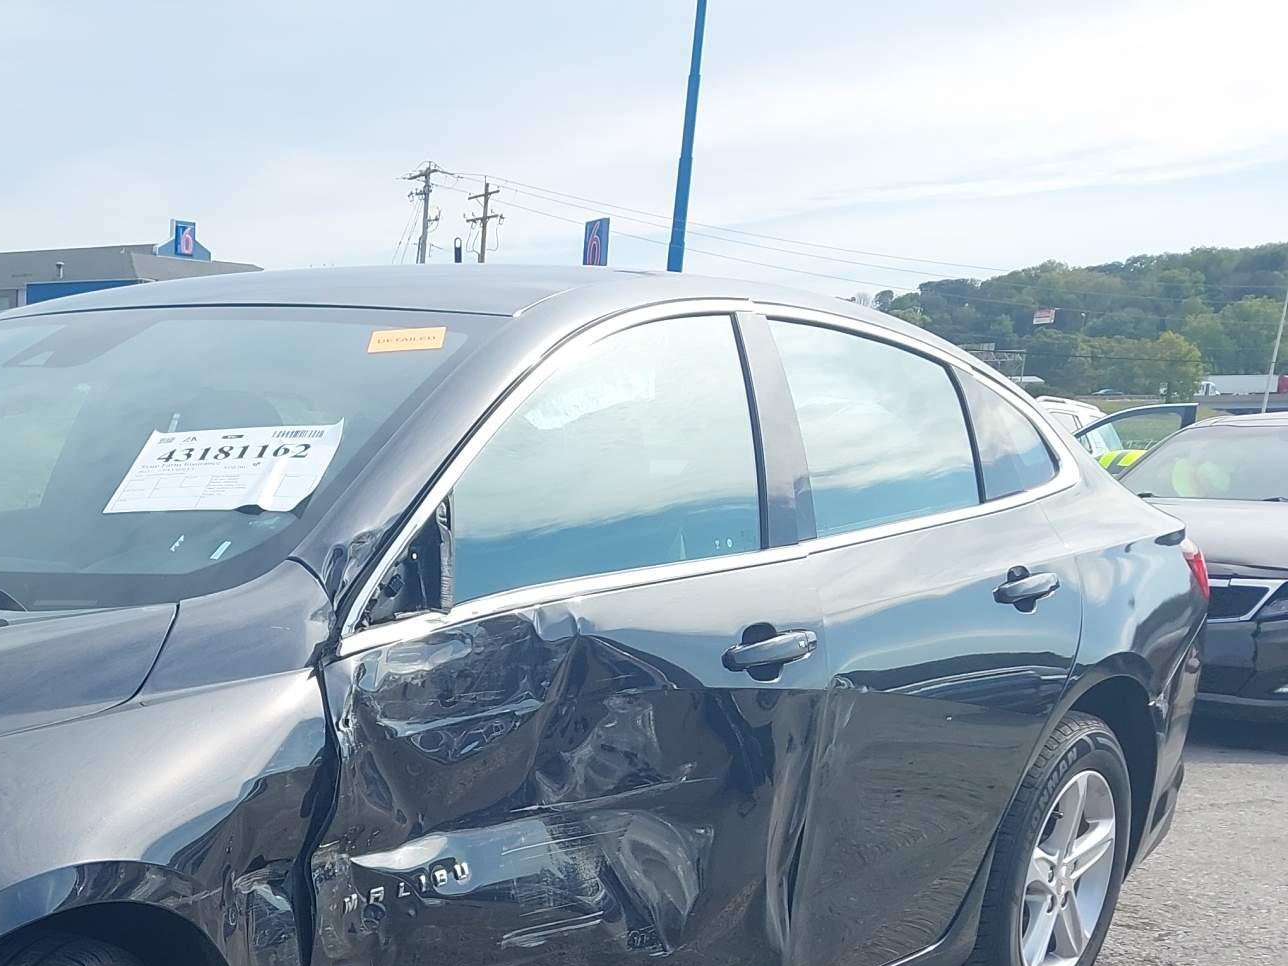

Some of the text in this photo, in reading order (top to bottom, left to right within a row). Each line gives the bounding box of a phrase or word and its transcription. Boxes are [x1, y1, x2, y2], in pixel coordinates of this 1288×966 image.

[180, 227, 193, 254] 6
[156, 444, 311, 463] 43181162
[342, 861, 469, 914] MALIBU
